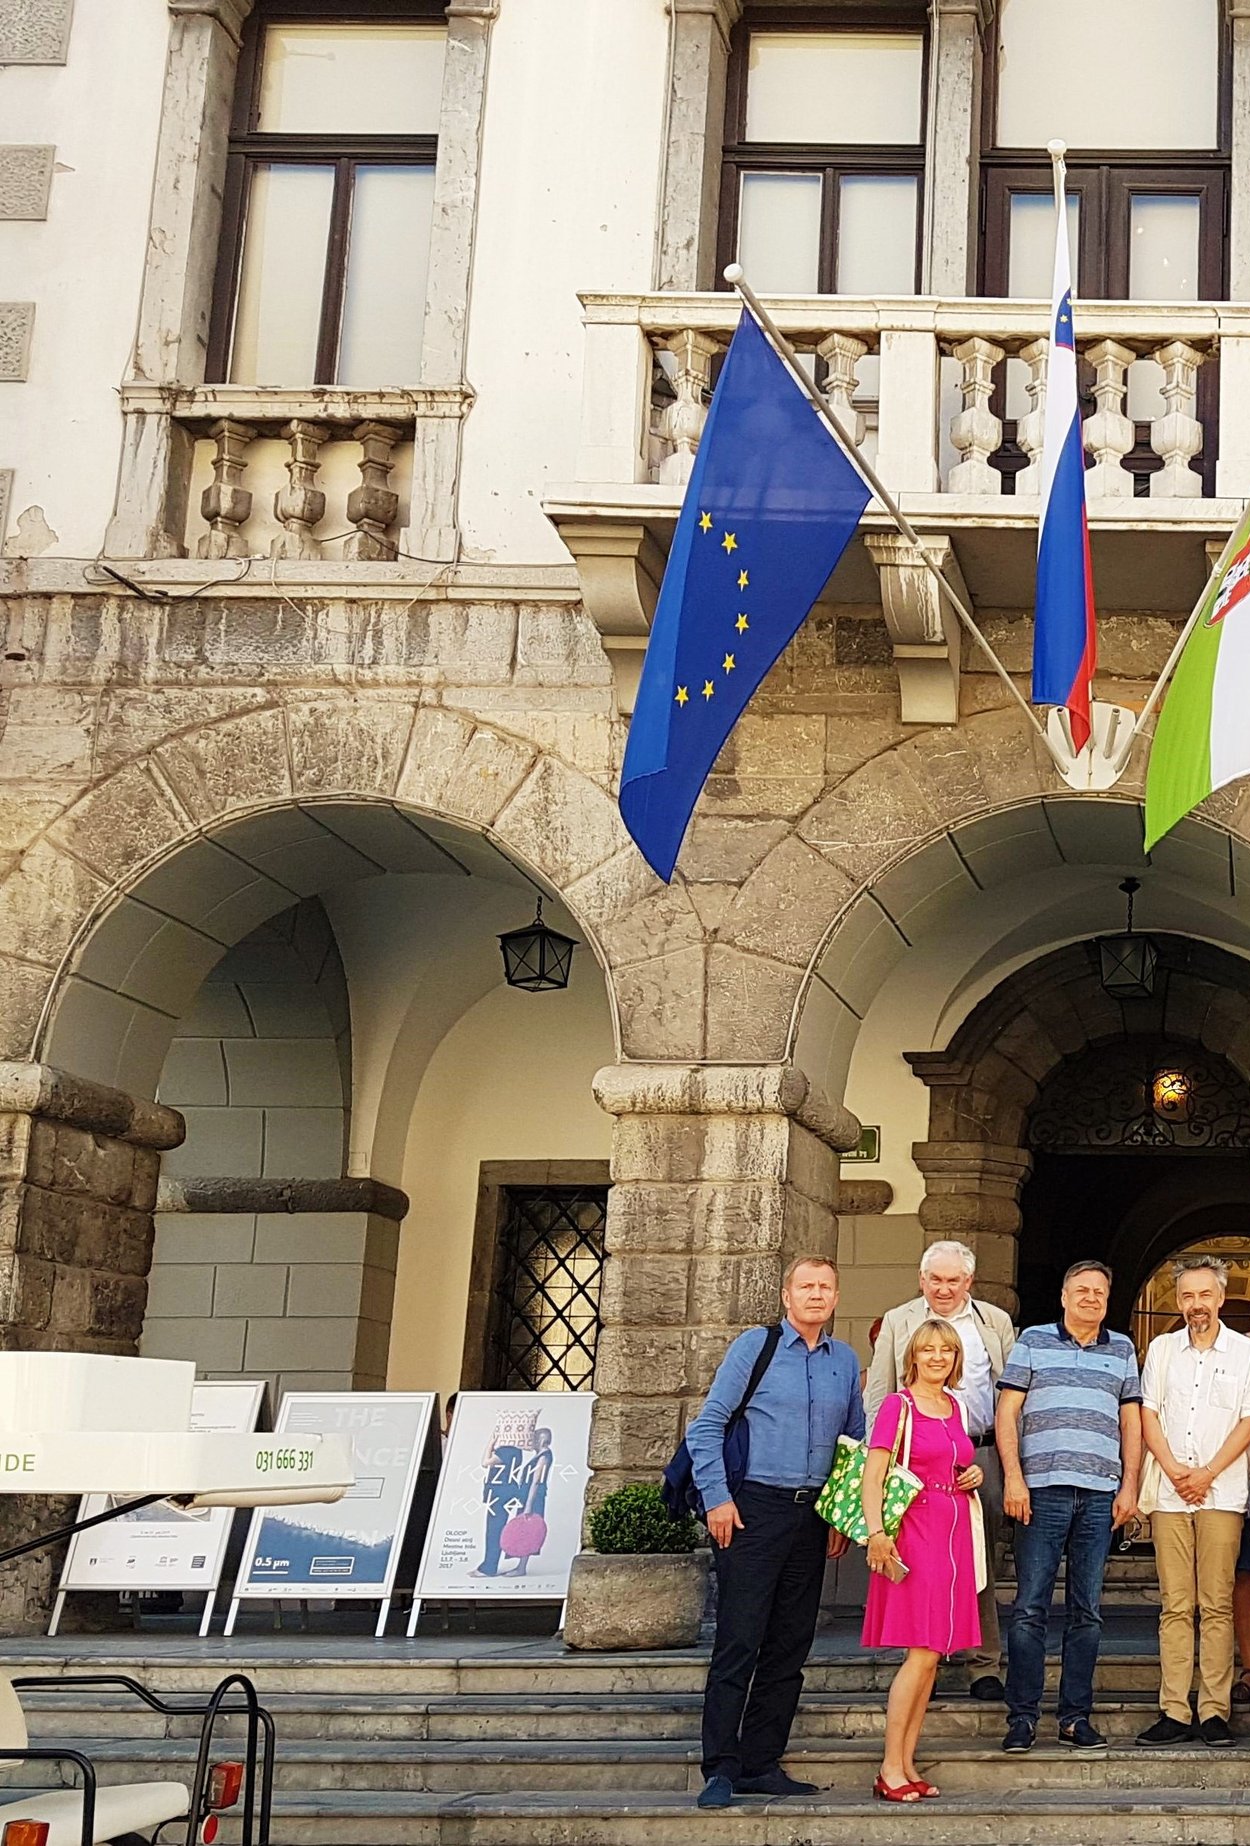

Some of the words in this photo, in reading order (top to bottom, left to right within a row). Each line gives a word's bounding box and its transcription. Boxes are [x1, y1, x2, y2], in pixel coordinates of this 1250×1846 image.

[335, 1407, 388, 1428] THE
[0, 1453, 36, 1472] DE
[256, 1450, 274, 1472] 031
[276, 1448, 296, 1470] 666
[298, 1450, 314, 1472] 331
[255, 1557, 272, 1567] 0.5
